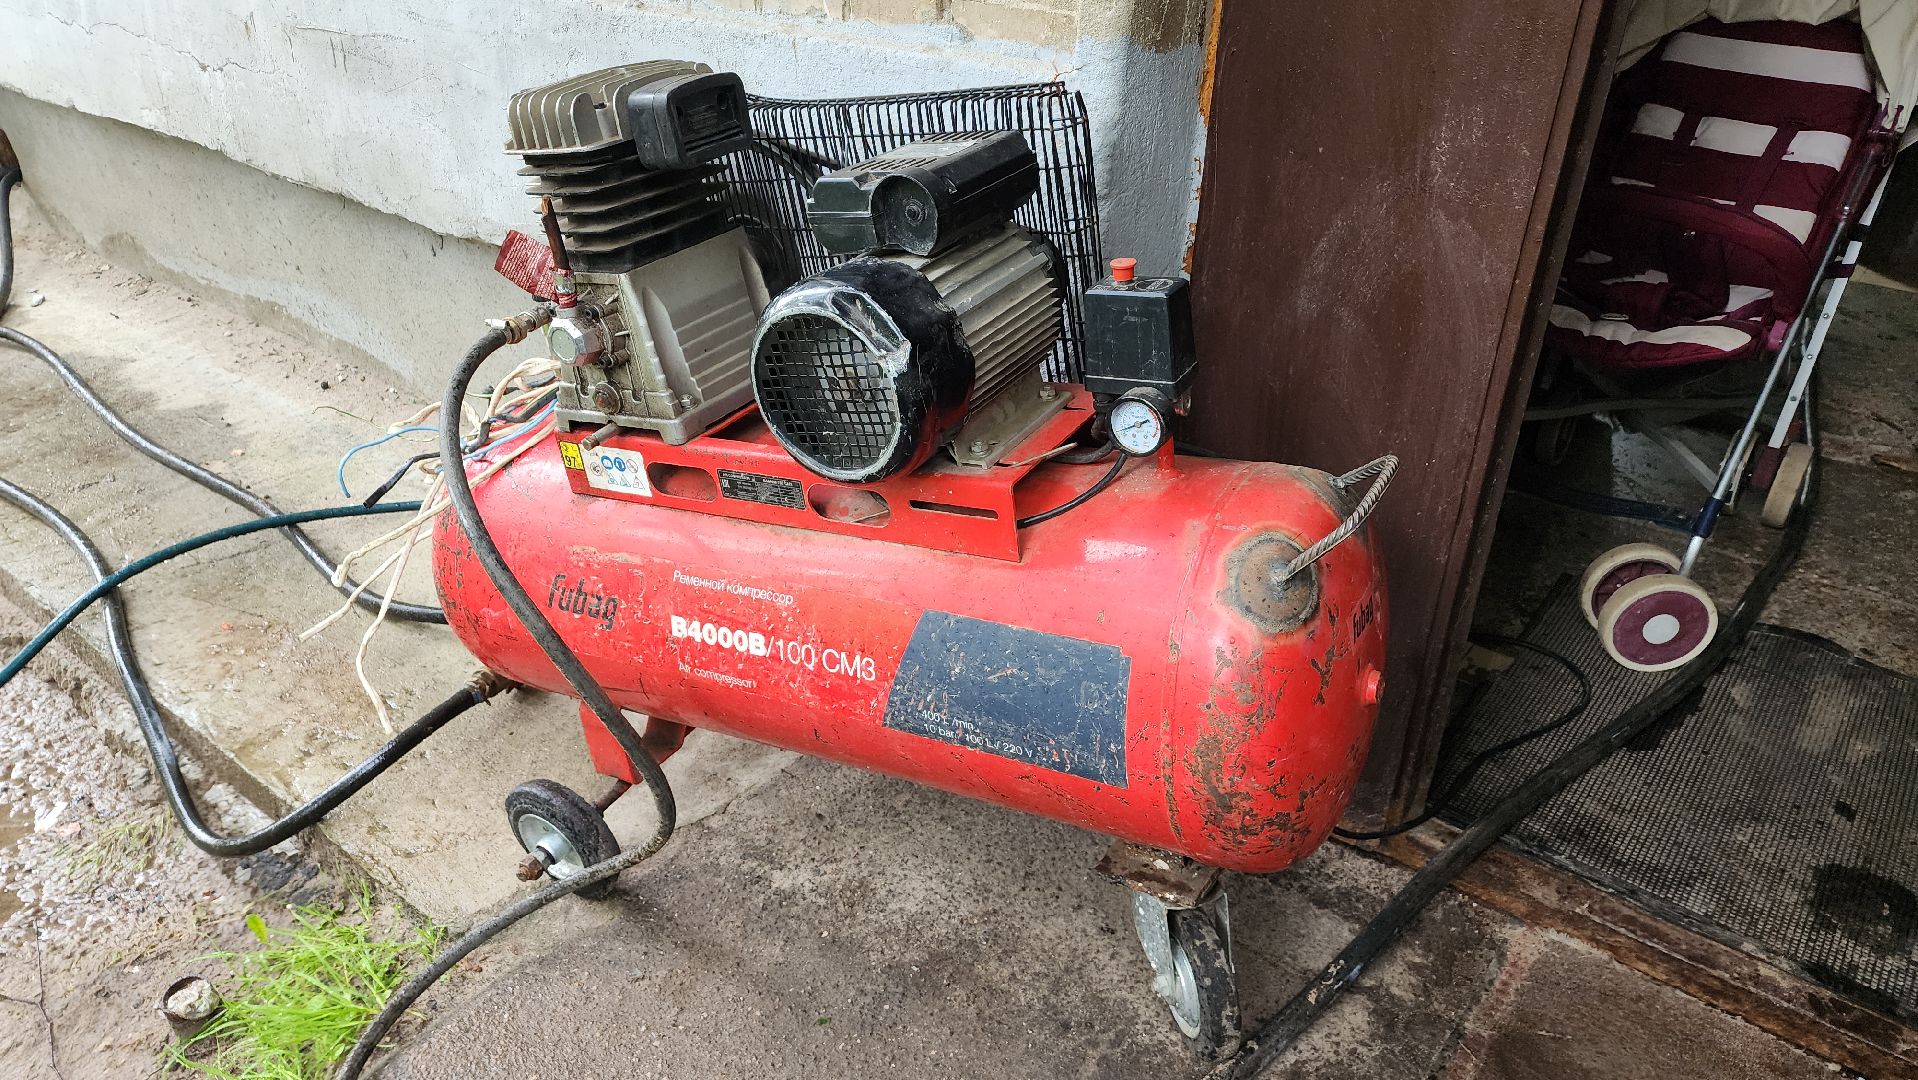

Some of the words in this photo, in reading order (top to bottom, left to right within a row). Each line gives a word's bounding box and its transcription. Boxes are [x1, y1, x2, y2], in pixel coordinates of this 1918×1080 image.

[673, 570, 725, 592] Ременной
[726, 582, 794, 606] компрессор
[670, 615, 815, 670] B4000B/100
[924, 723, 936, 734] 10
[1002, 742, 1023, 755] 220
